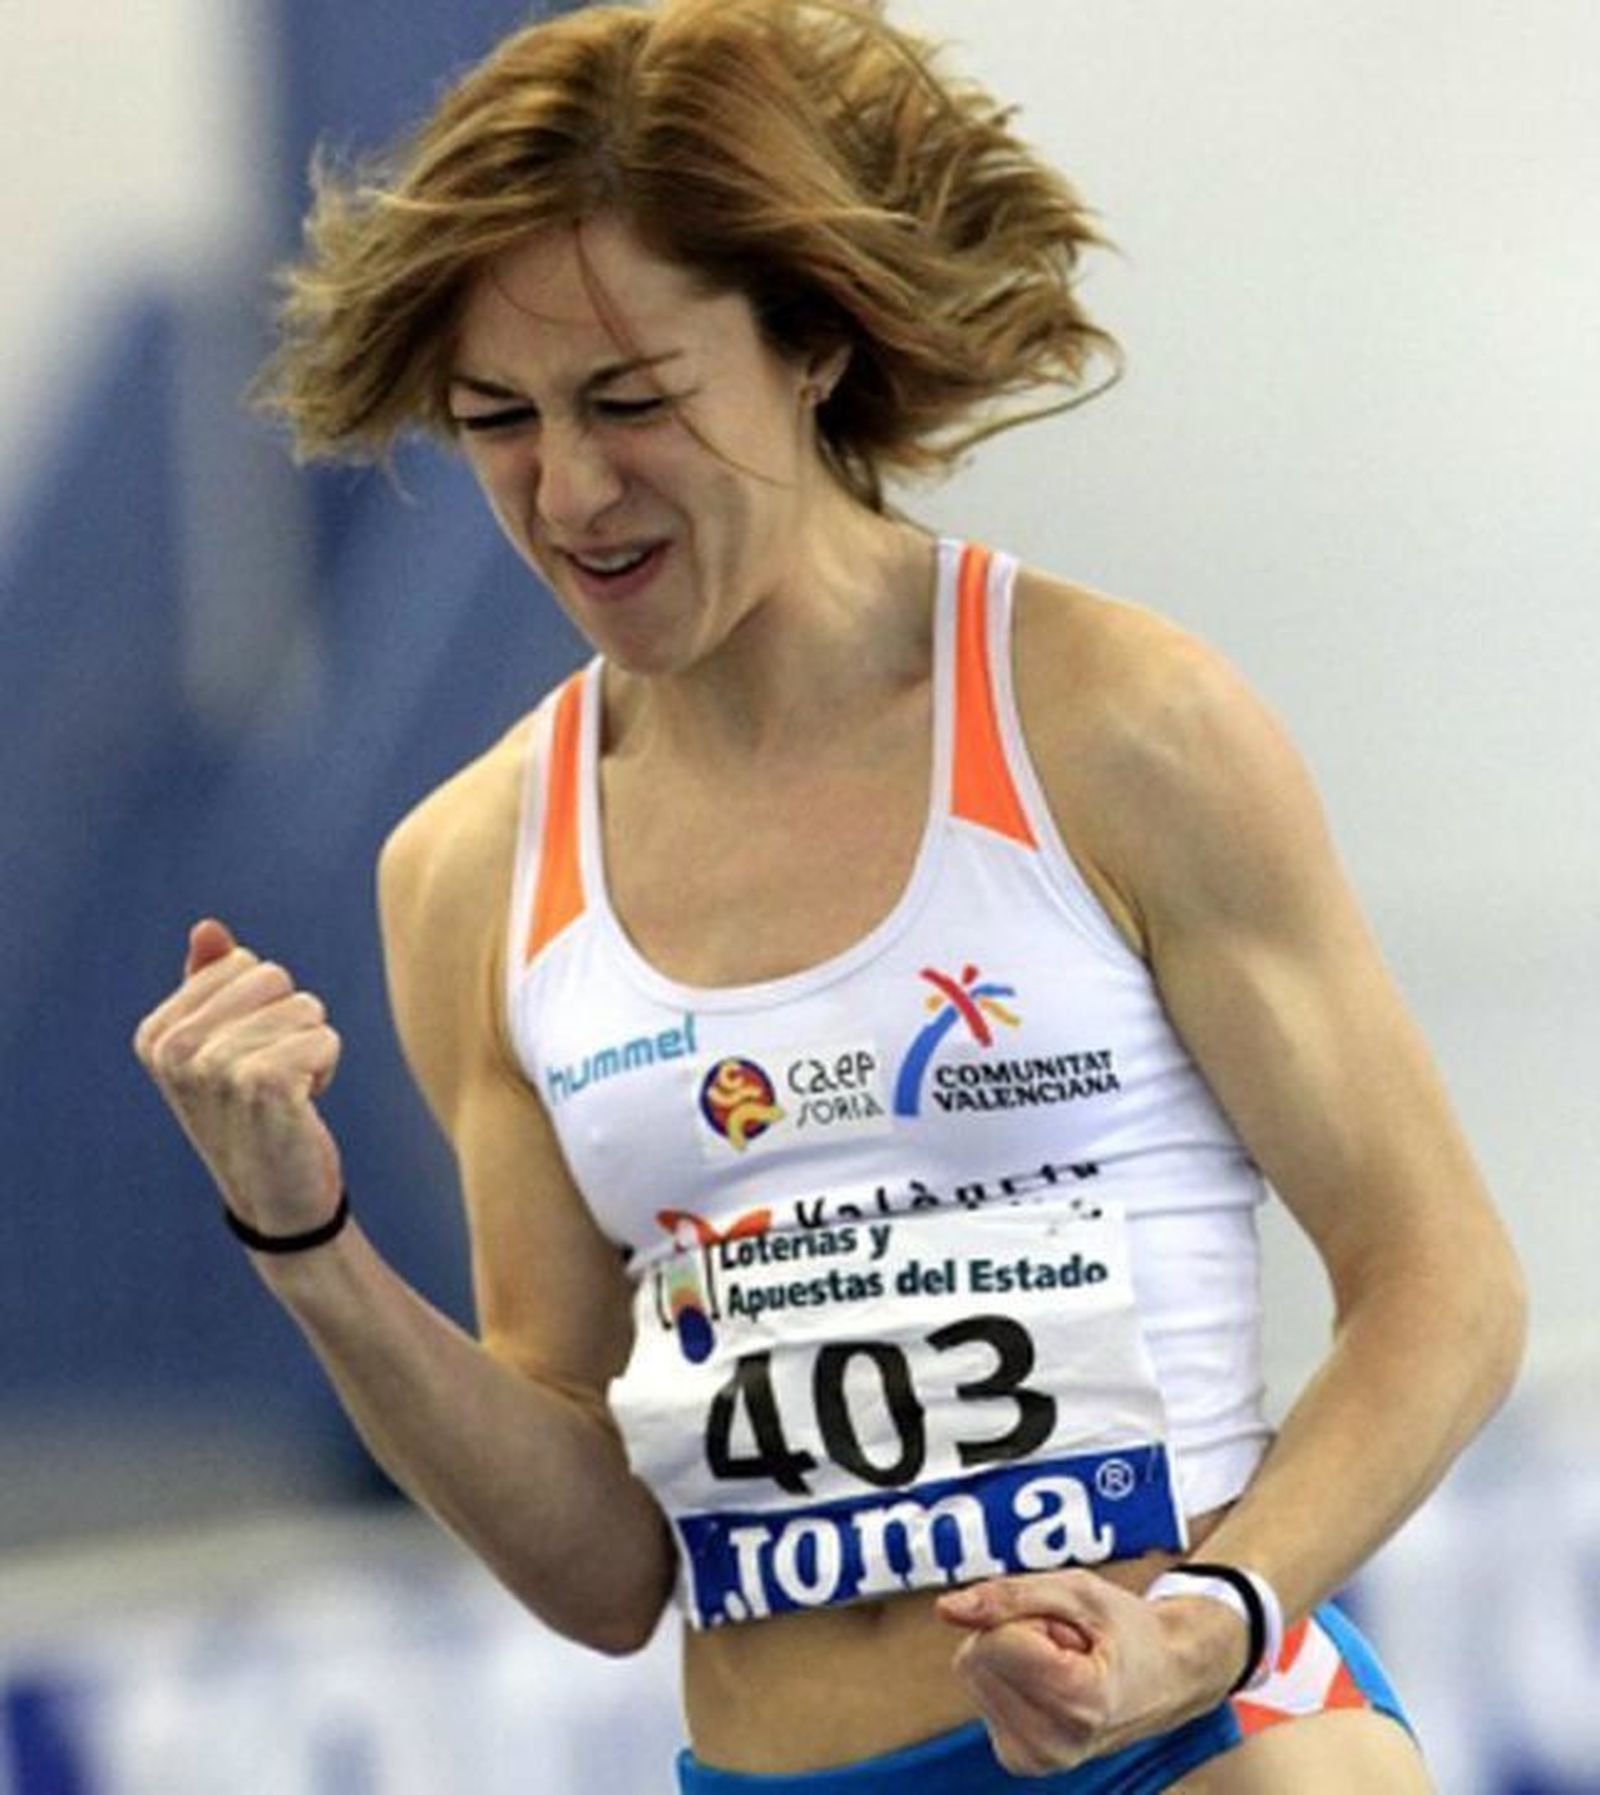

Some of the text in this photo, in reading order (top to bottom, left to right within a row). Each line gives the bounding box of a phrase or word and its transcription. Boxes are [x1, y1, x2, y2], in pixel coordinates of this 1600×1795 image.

[547, 1011, 697, 1104] hummel
[936, 1050, 1113, 1090] COMUNITAT
[932, 1074, 1121, 1112] VALENCIANA
[868, 1224, 891, 1260] y
[728, 1254, 1109, 1323] Apuestas del Estado
[706, 1315, 1057, 1495] 403
